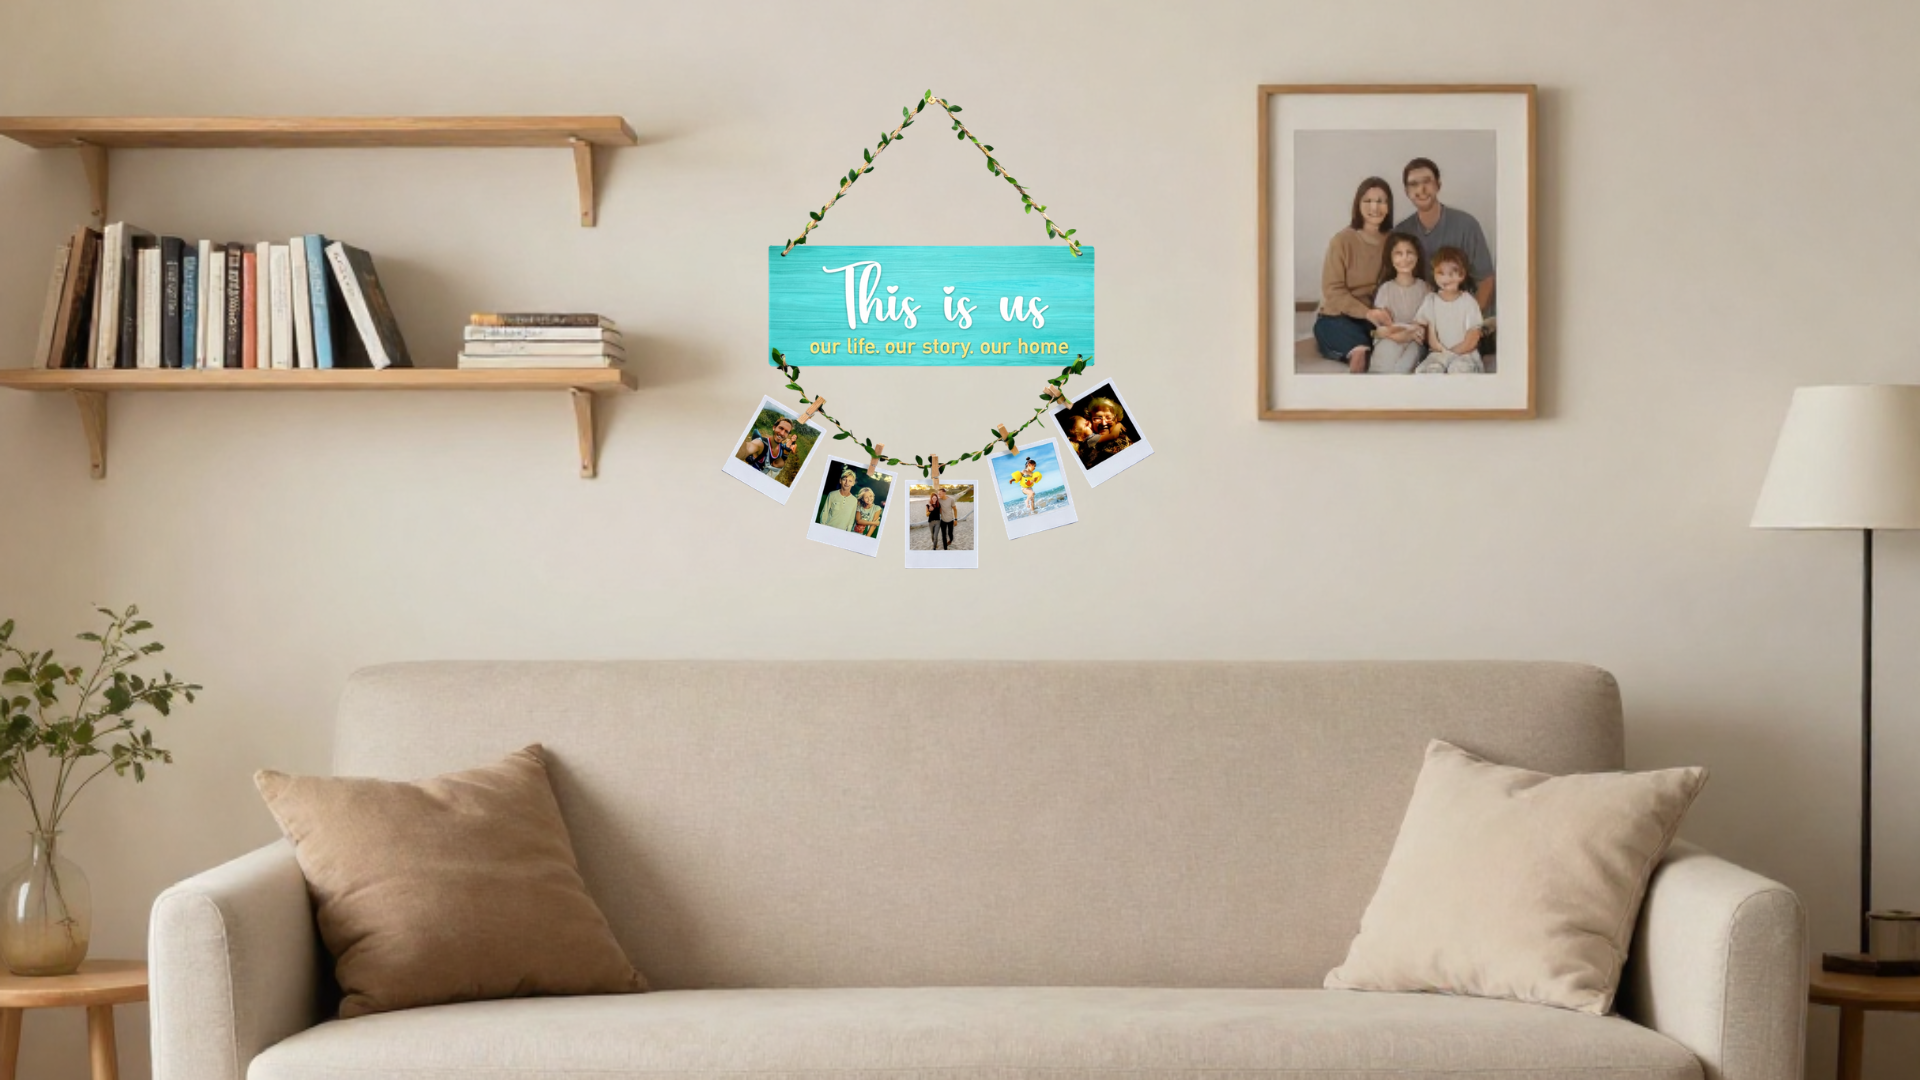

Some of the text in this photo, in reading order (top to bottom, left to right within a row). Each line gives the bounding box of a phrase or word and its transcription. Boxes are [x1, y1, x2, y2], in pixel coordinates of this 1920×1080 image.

[822, 260, 1049, 330] This is us
[810, 337, 1069, 359] our life. our story. our home
